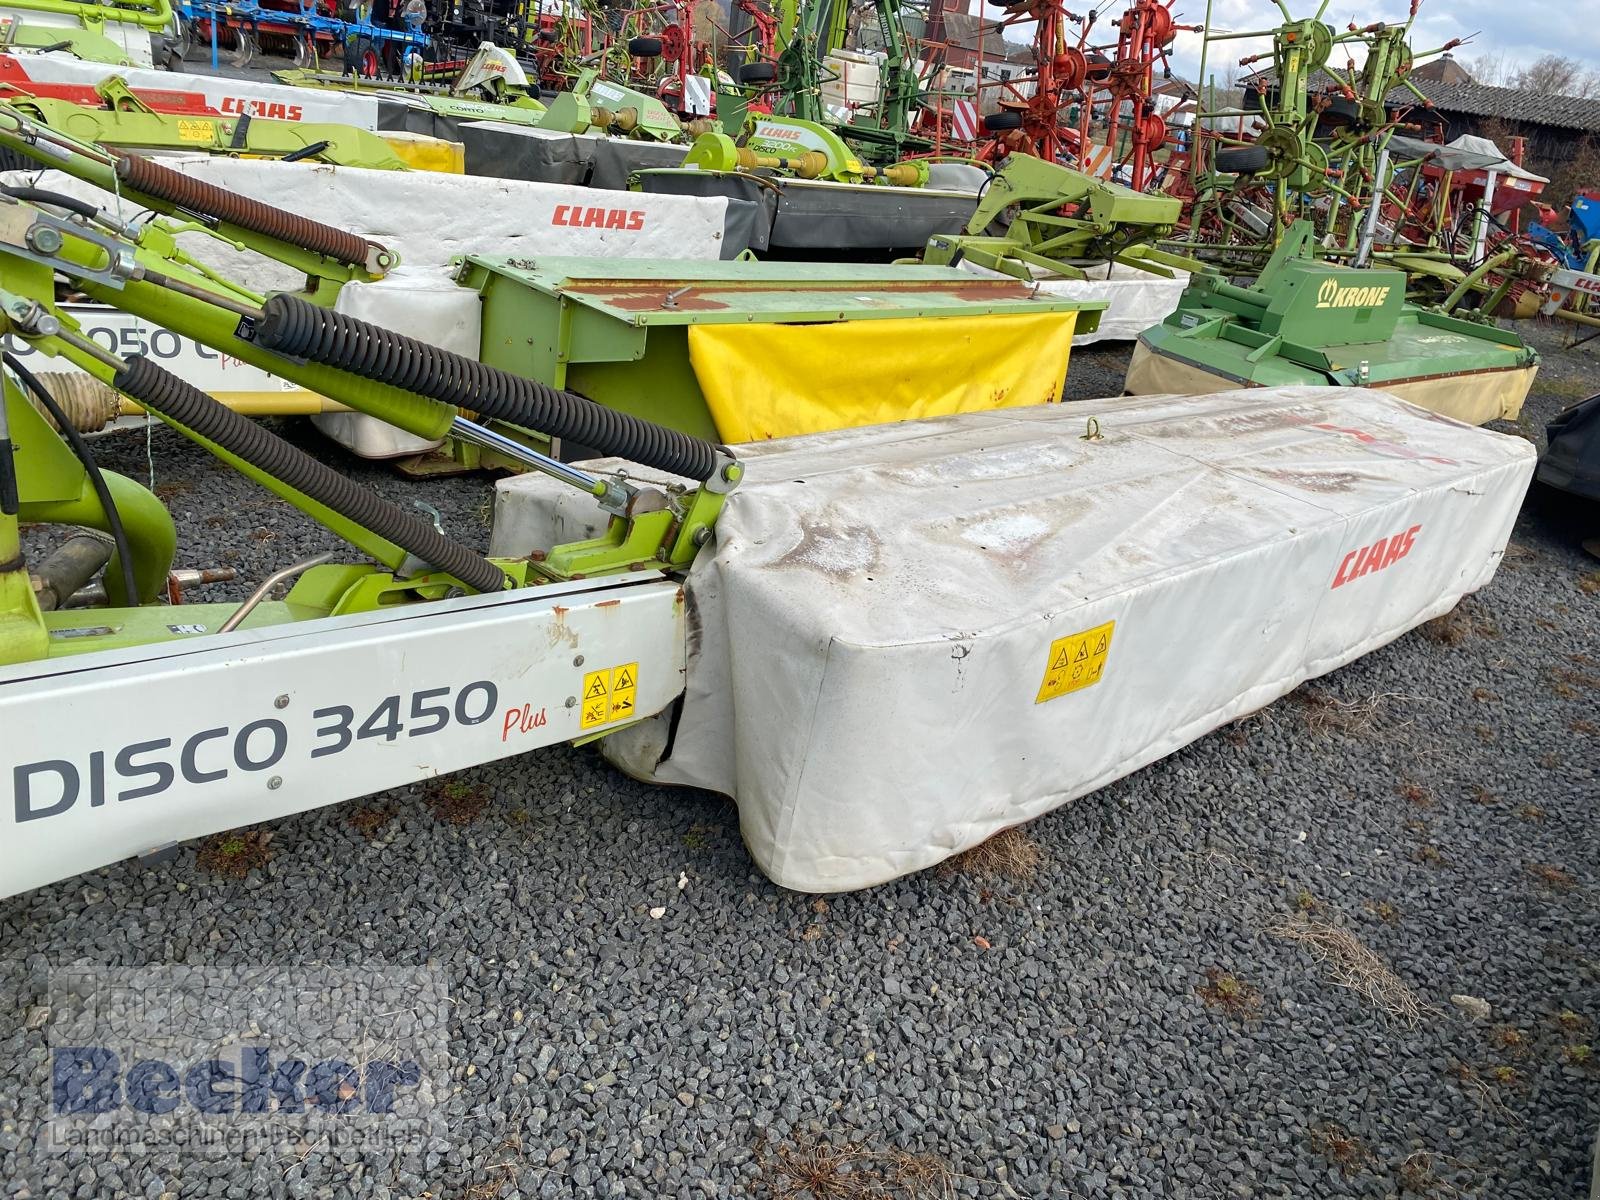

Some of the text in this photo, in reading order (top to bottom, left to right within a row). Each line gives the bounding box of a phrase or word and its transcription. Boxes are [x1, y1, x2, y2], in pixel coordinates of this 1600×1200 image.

[759, 127, 801, 140] CLAAS
[753, 144, 777, 154] DISCO
[552, 205, 646, 231] CLAAS
[1332, 287, 1390, 308] KRONE
[1331, 524, 1423, 590] CLAAS
[13, 680, 547, 823] DISCO 3450 Plus
